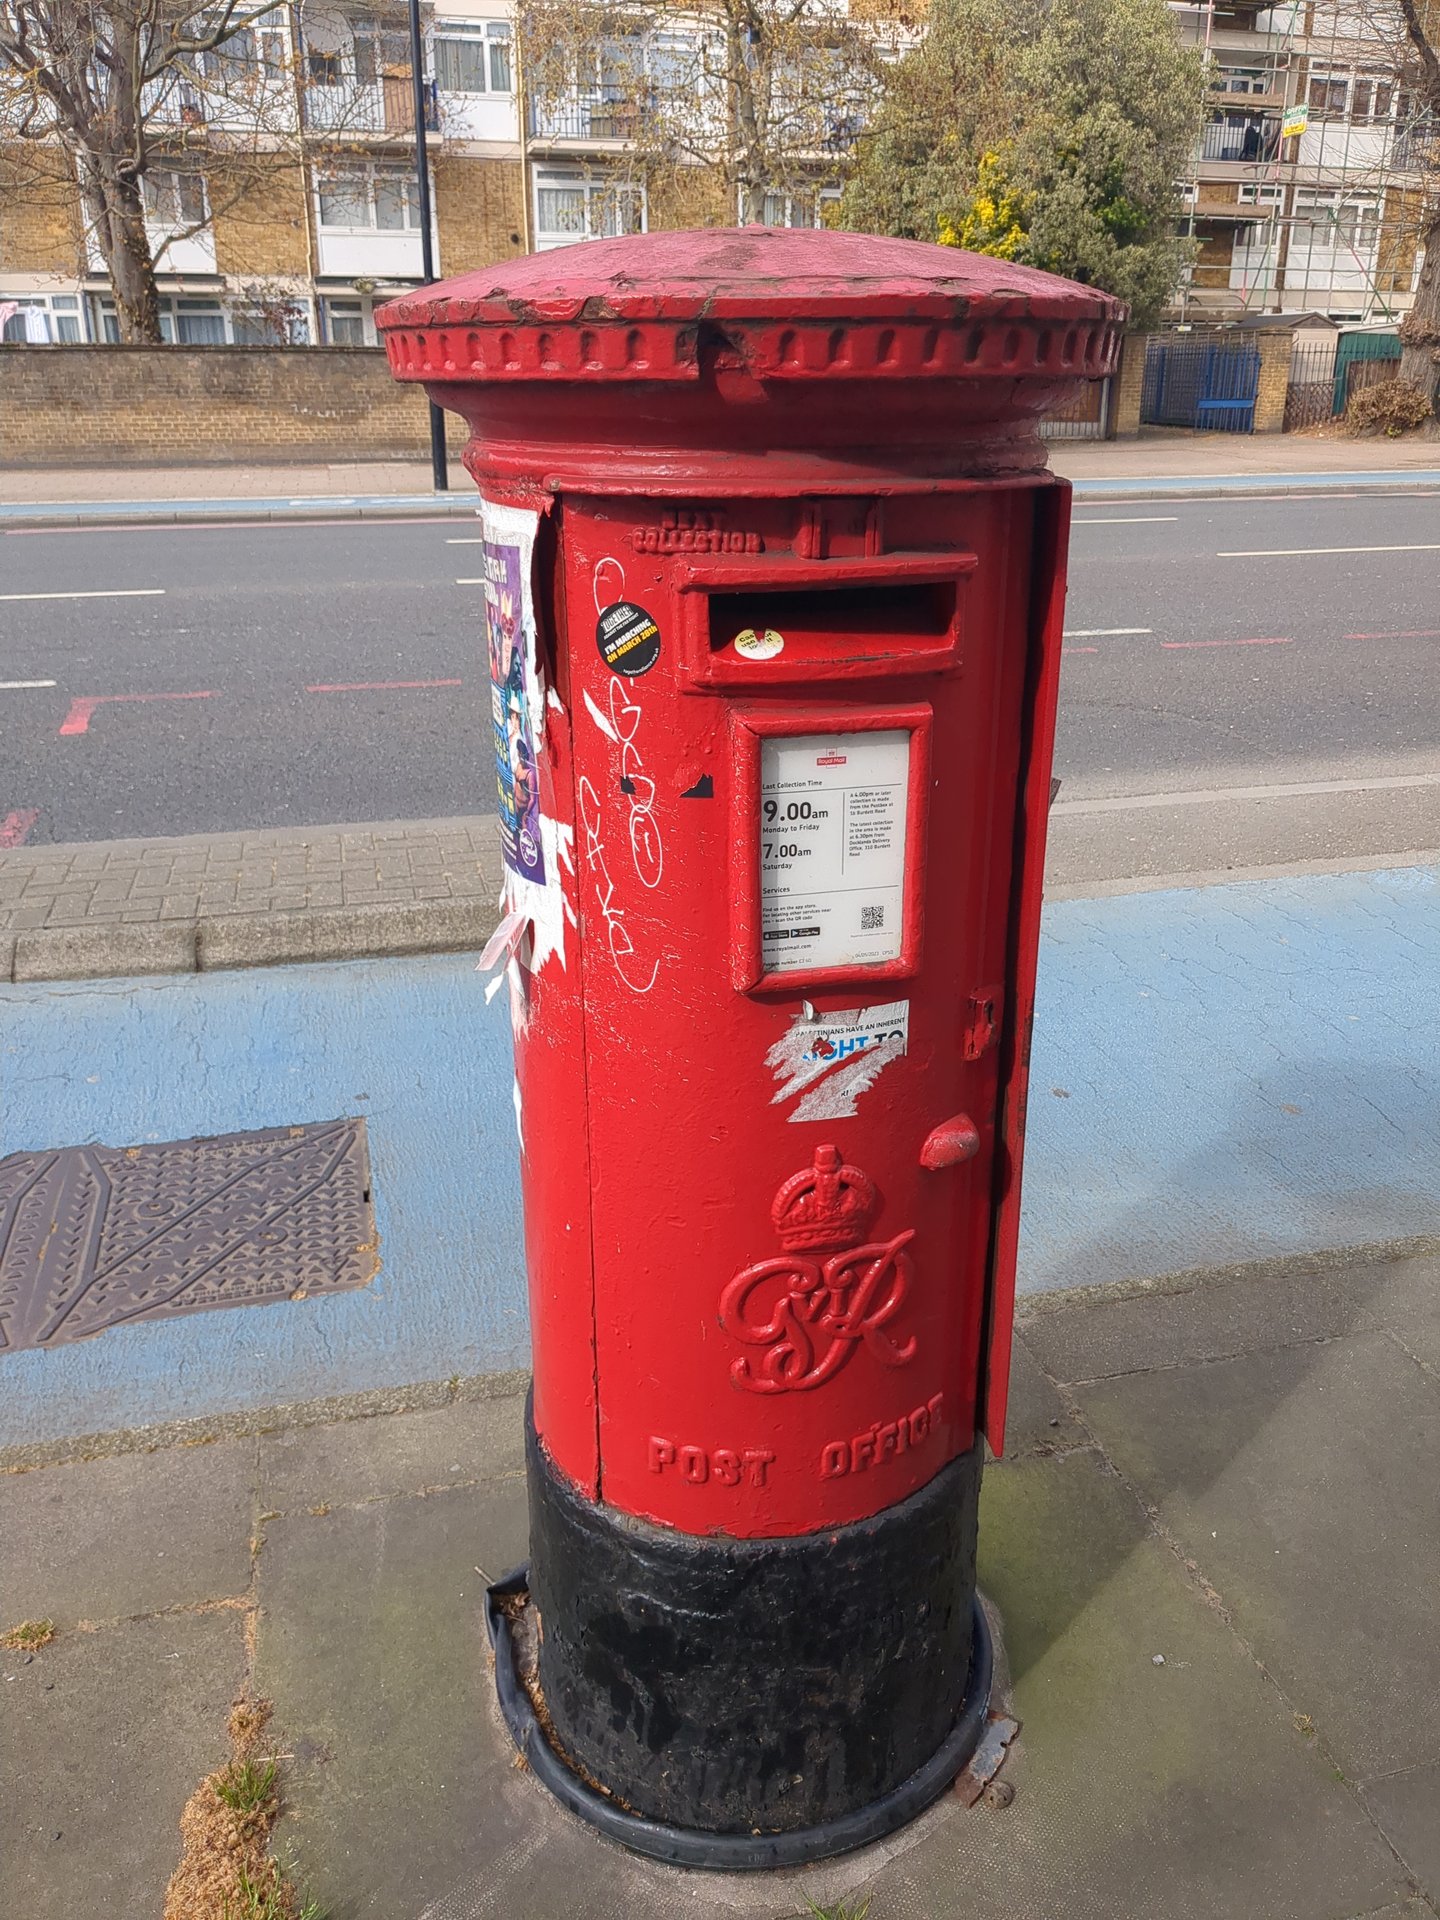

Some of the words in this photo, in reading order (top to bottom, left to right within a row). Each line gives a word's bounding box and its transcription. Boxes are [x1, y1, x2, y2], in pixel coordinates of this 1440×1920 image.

[632, 526, 763, 554] COLLECTION
[601, 604, 634, 633] TOGETHER
[604, 642, 617, 655] I'M
[615, 618, 651, 647] MARCHING
[607, 653, 618, 663] ON
[617, 636, 641, 656] MARCH
[640, 625, 657, 640] 28th
[739, 634, 754, 642] Cas
[764, 800, 828, 822] 9.00am
[763, 844, 811, 859] 7.00am
[876, 1017, 905, 1027] INHERENT
[650, 1435, 775, 1486] POST
